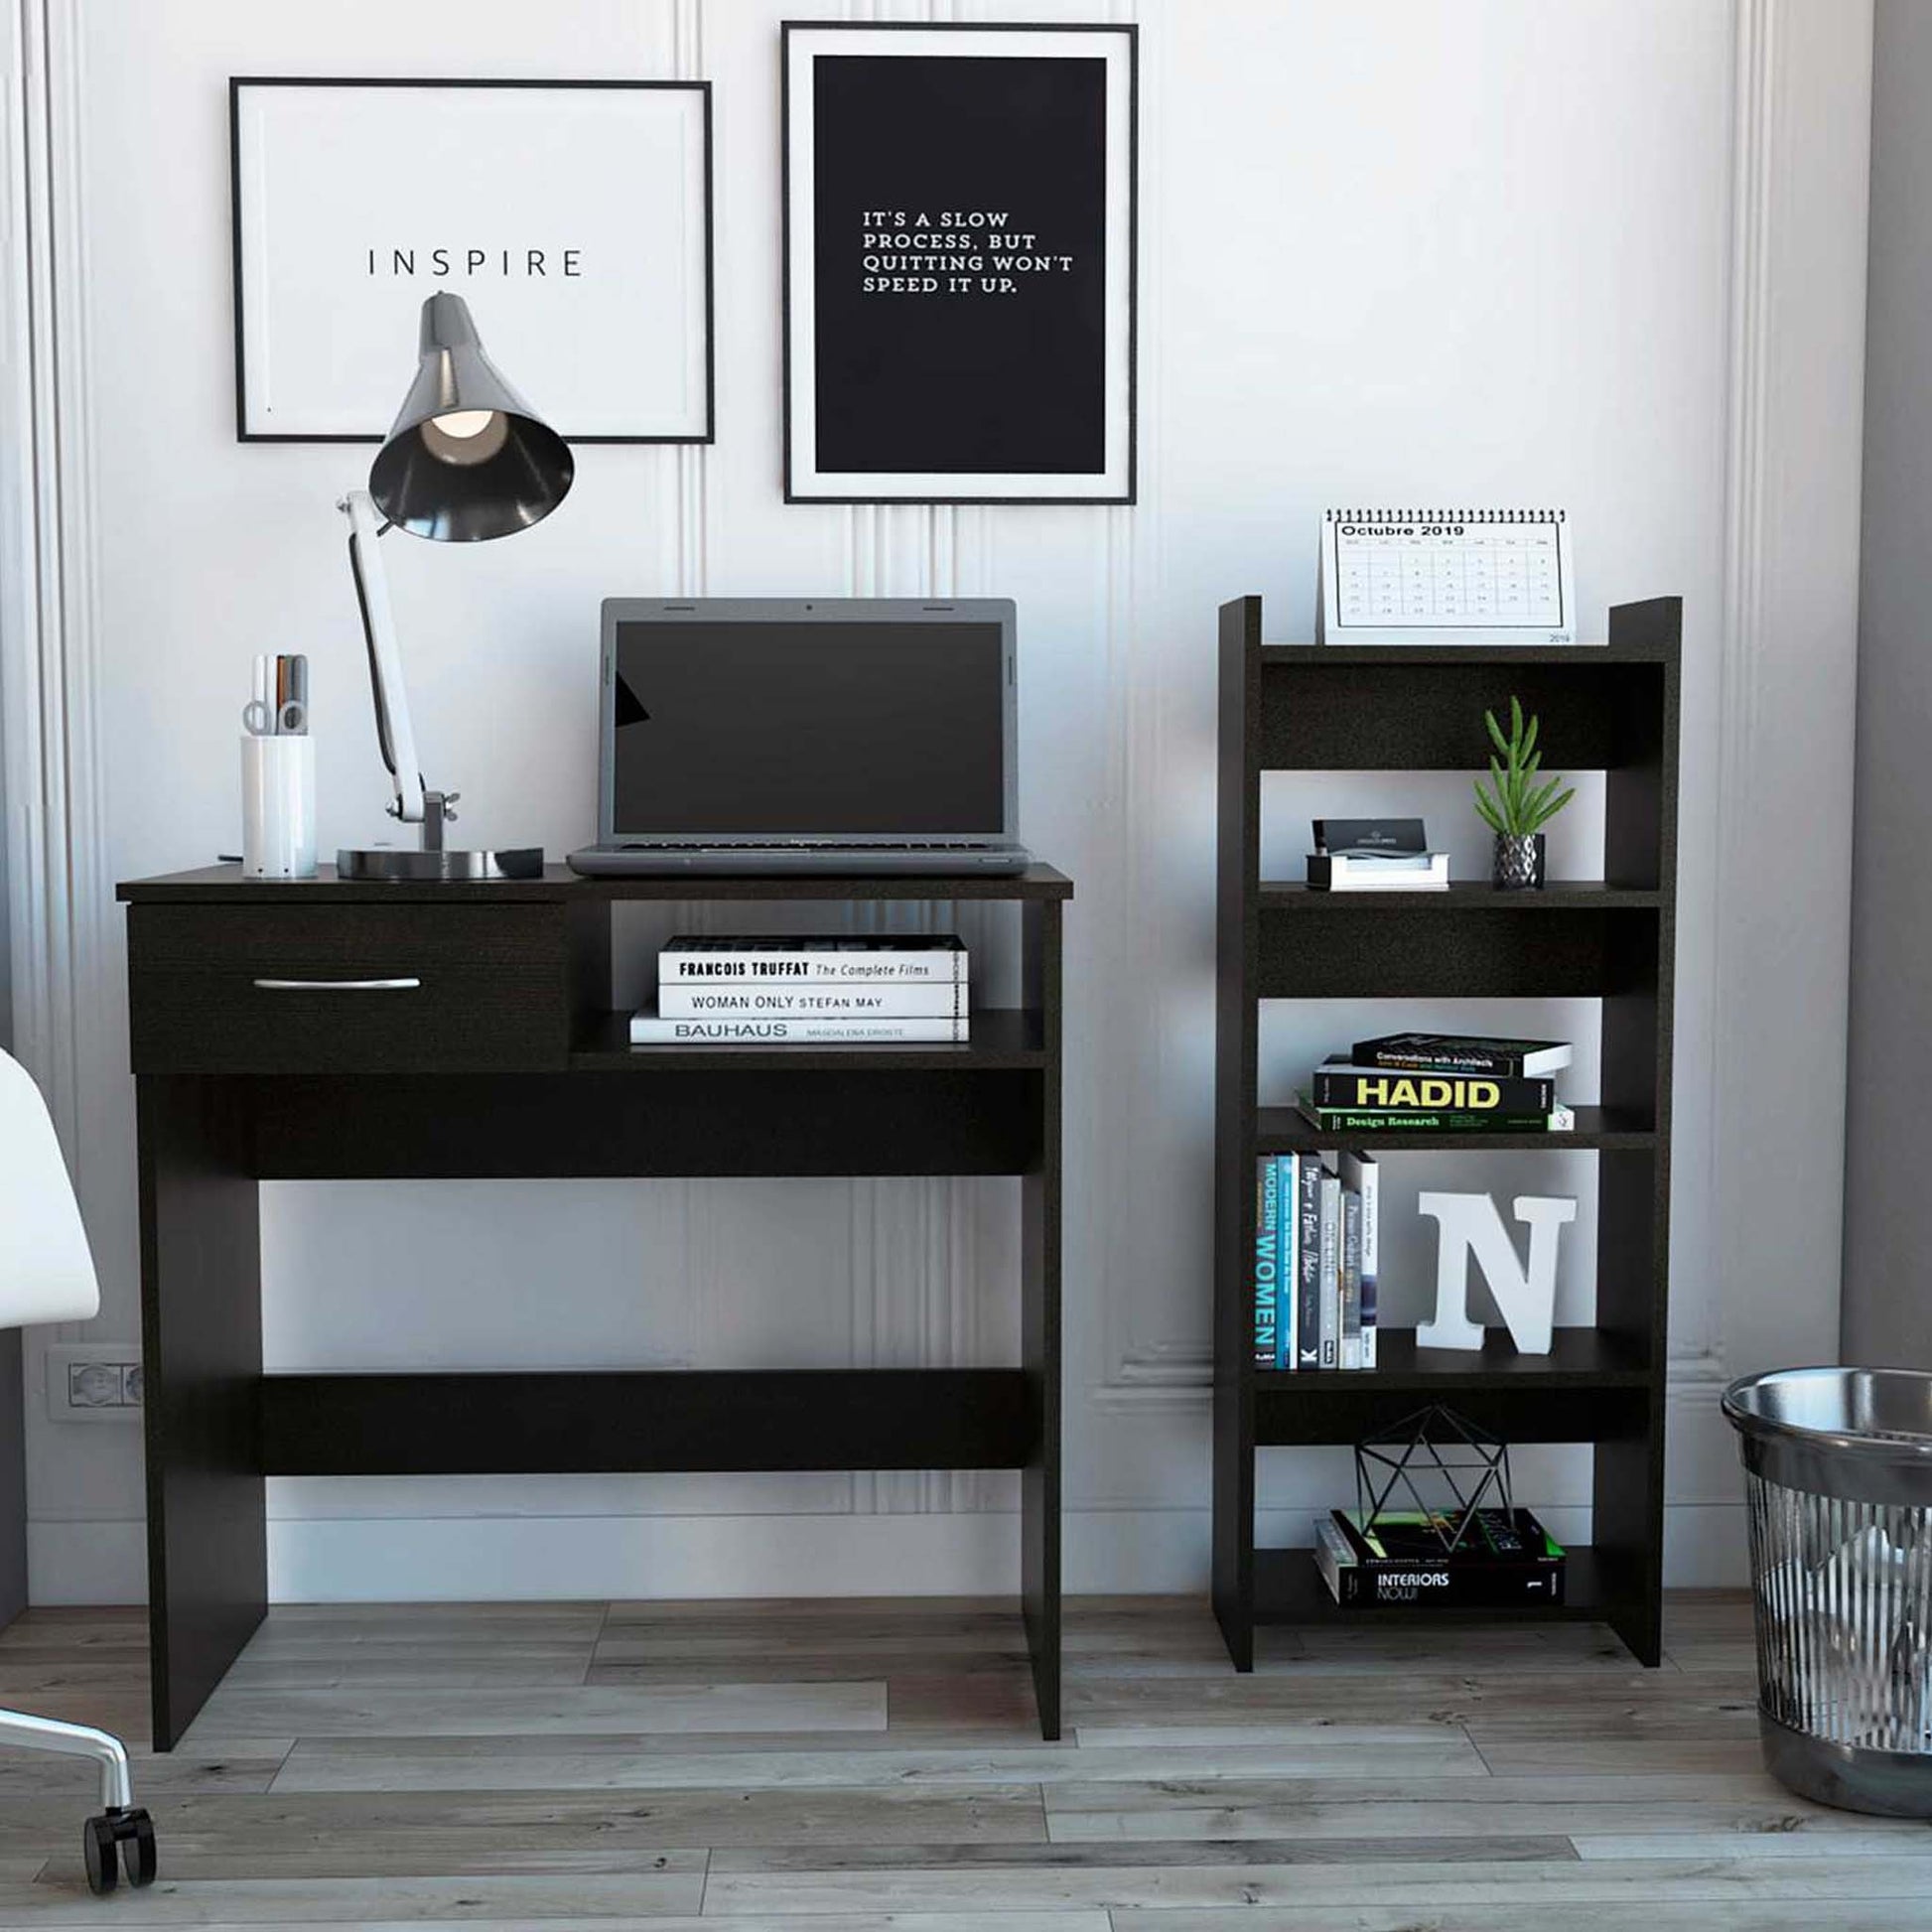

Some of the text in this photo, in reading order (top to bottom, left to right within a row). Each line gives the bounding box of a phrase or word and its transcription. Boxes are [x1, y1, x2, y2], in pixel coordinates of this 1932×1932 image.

[863, 211, 1009, 227] IT'S A SLOW
[863, 233, 1035, 250] PROCESS, BUT
[368, 249, 583, 277] INSPIRE
[863, 255, 1073, 273] QUITTING WON'T
[863, 277, 1017, 293] SPEED IT UP.
[1341, 525, 1464, 536] Octubre 2019
[679, 962, 929, 978] FRANCOIS TRUFFAT The Complete Films
[692, 996, 883, 1009] WOMAN ONLY STEFAN MAY
[675, 1024, 787, 1037] BAUHAUS
[1357, 1078, 1500, 1108] HADID
[1346, 1117, 1385, 1129] Design
[1388, 1117, 1440, 1127] Research
[1264, 1164, 1277, 1231] MODERN
[1416, 1191, 1578, 1355] N
[1256, 1235, 1277, 1344] WOMEN
[1377, 1573, 1449, 1587] INTERIORS
